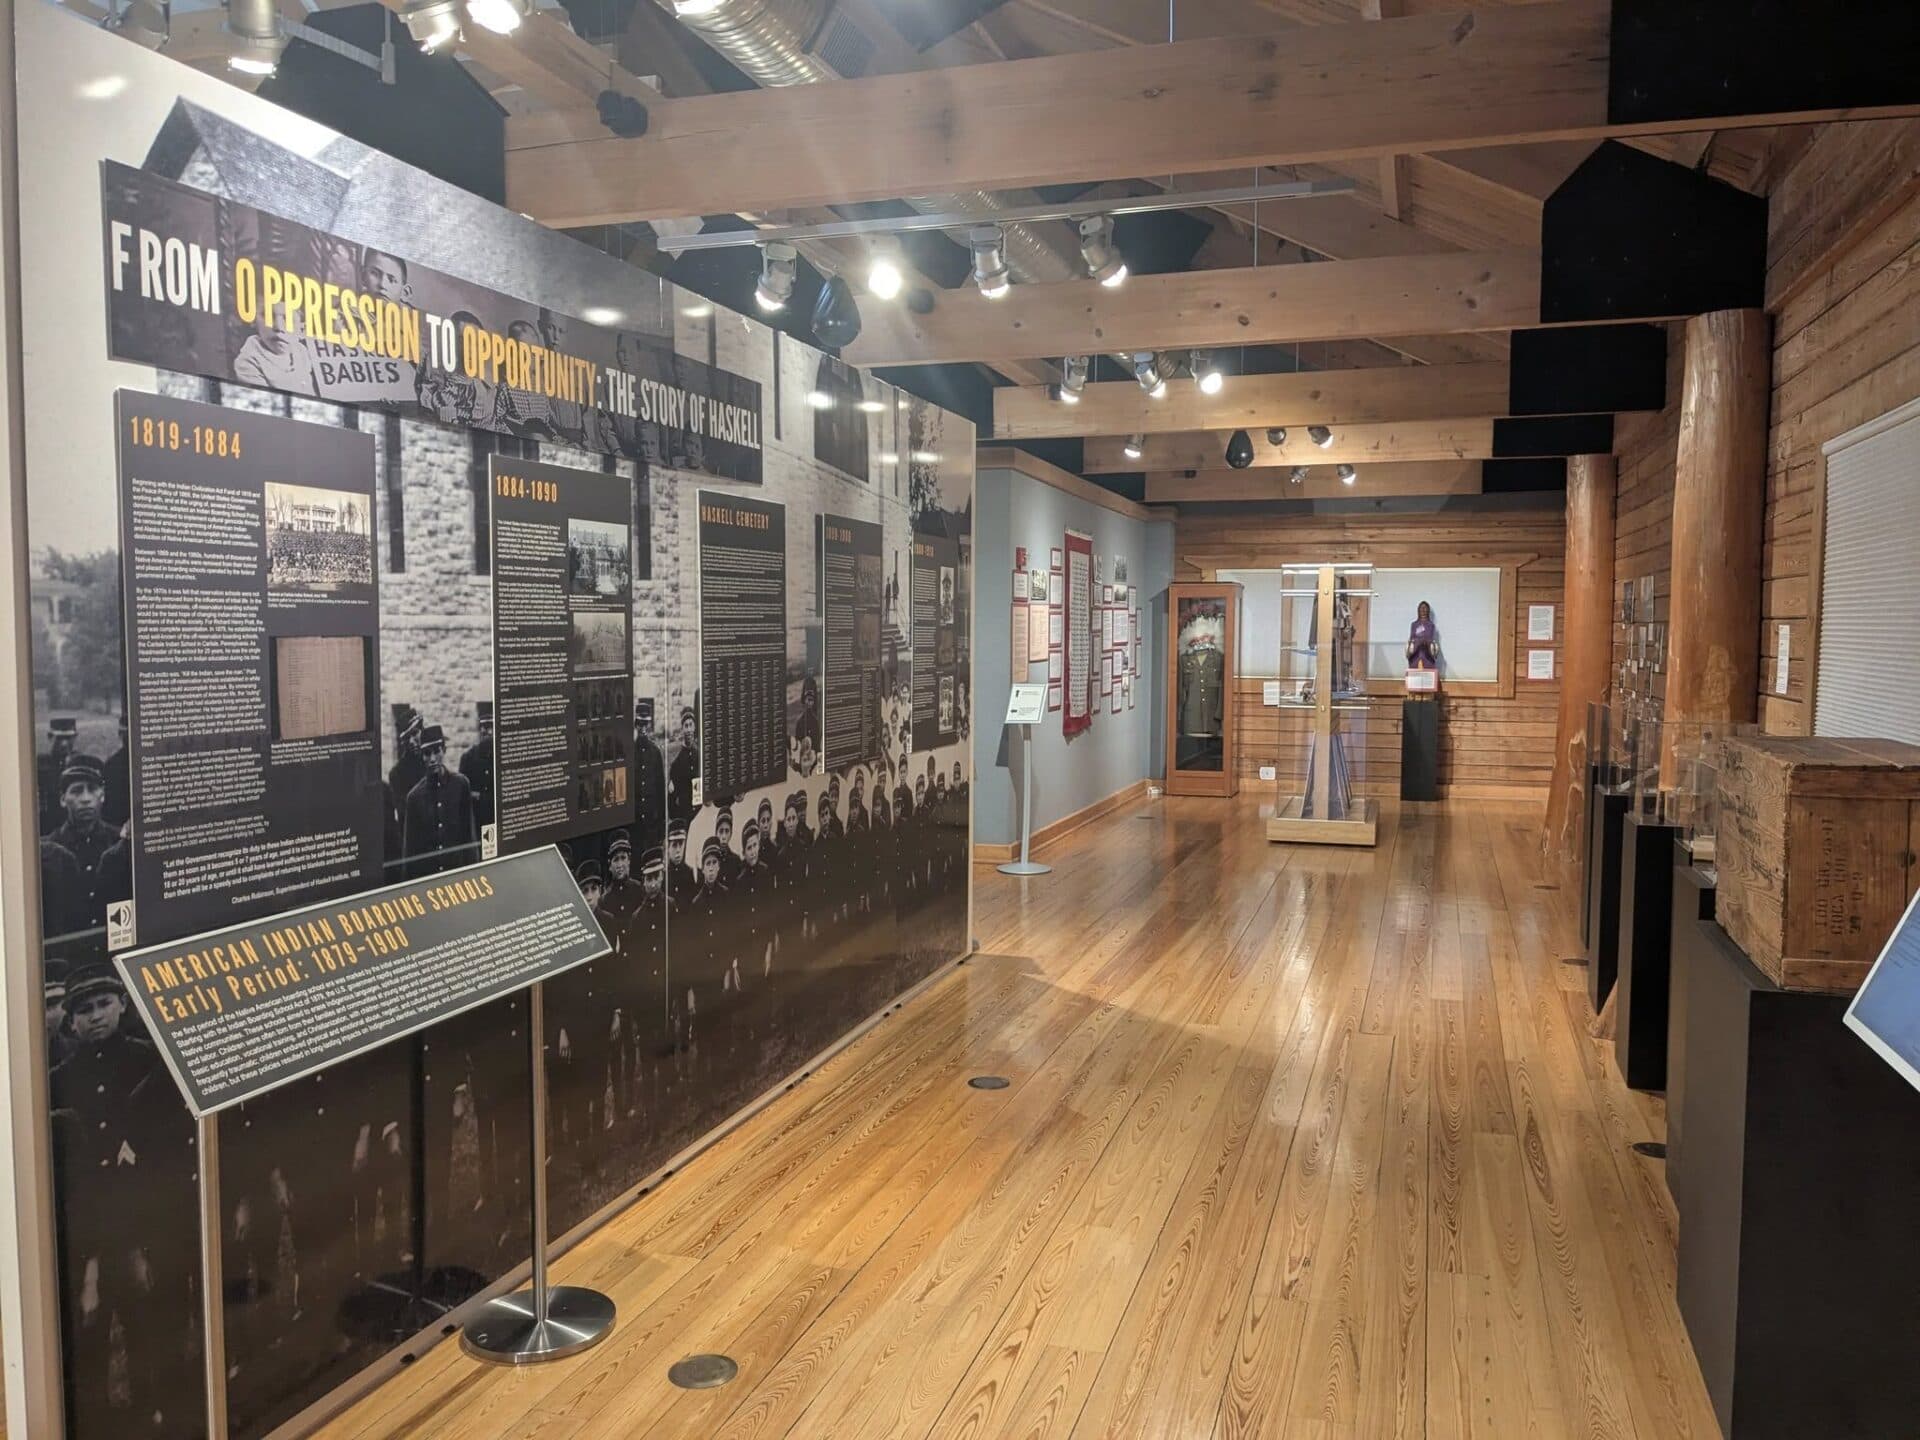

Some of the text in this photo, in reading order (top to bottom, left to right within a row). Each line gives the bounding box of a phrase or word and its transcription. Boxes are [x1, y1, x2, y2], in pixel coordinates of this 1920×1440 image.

[110, 219, 762, 450] FROM OPPRESSION TO OPPORTUNITY: THE STORY OF HASKELL
[319, 361, 401, 385] BABIES
[131, 415, 241, 460] 1819-1884
[496, 474, 558, 503] 1884-1890
[701, 505, 769, 530] HASKELL CEMETERY
[141, 876, 492, 992] AMERICAN INDIAN BOARDING SCHOOLS
[154, 986, 223, 1023] Early
[226, 959, 309, 999] Period:
[170, 1030, 183, 1038] the
[182, 1024, 197, 1034] first
[196, 1018, 218, 1031] period
[234, 1007, 255, 1017] Native
[254, 998, 283, 1010] American
[281, 990, 308, 1001] boarding
[307, 983, 325, 993] school
[175, 1035, 204, 1047] Starting
[202, 1029, 217, 1039] with
[215, 1026, 228, 1034] the
[226, 1020, 247, 1030] Indian
[246, 1011, 275, 1023] Boarding
[272, 1003, 294, 1014] School
[292, 999, 304, 1008] Act
[180, 1046, 203, 1057] Native
[202, 1032, 244, 1049] communities.
[243, 1025, 264, 1035] These
[263, 1017, 286, 1028] schools
[286, 1010, 304, 1020] aimed
[309, 1003, 326, 1012] erase
[186, 1056, 200, 1066] and
[199, 1052, 219, 1062] labor.
[217, 1042, 246, 1055] Children
[245, 1036, 261, 1046] were
[260, 1031, 277, 1040] often
[275, 1027, 289, 1035] torn
[287, 1022, 302, 1030] from
[301, 1017, 315, 1025] their
[313, 1010, 336, 1021] families
[335, 1005, 347, 1013] and
[190, 1066, 210, 1076] basic
[209, 1055, 243, 1070] education,
[242, 1042, 273, 1058] vocational
[272, 1035, 296, 1046] training,
[295, 1029, 308, 1038] and
[306, 1016, 350, 1034] Christianization,
[195, 1070, 229, 1086] frequently
[258, 1050, 283, 1063] children
[282, 1040, 307, 1054] endured
[306, 1032, 329, 1046] physical
[328, 1028, 340, 1036] and
[201, 1082, 230, 1096] children,
[228, 1075, 241, 1085] but
[239, 1070, 258, 1081] these
[257, 1061, 281, 1075] policies
[280, 1051, 305, 1065] resulted
[309, 1038, 342, 1054] long-lasting
[340, 1030, 362, 1042] impacts
